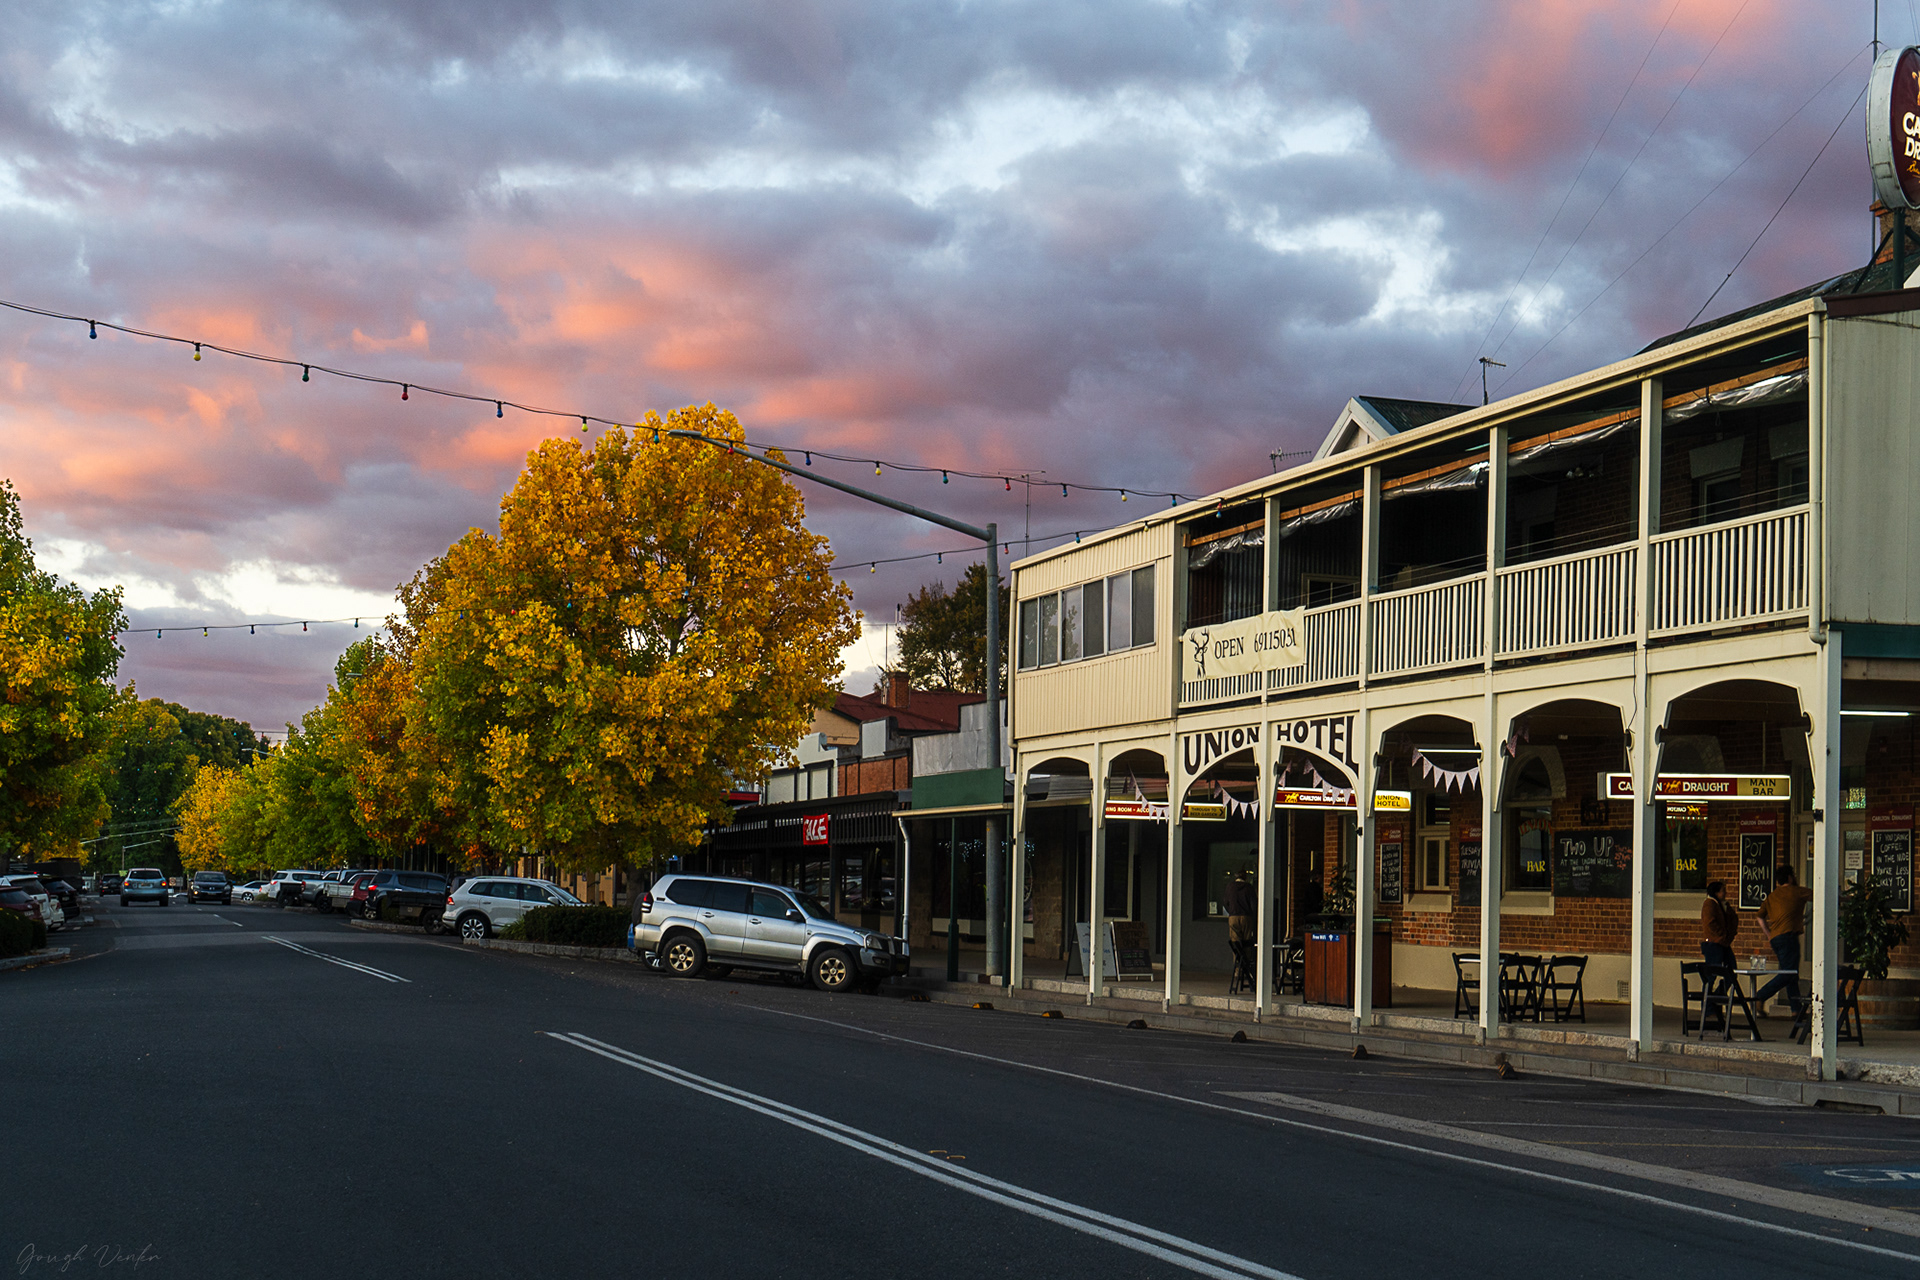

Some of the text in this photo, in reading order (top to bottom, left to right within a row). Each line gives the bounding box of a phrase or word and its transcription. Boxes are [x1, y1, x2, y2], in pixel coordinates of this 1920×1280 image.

[1214, 636, 1244, 660] OPEN
[1184, 716, 1359, 779] UNION HOTEL
[1682, 781, 1730, 792] DRAUGHT
[1749, 778, 1776, 787] MAIN
[1752, 787, 1774, 796] BAR
[1559, 837, 1587, 857] TWO
[1593, 835, 1615, 857] UP
[1744, 837, 1766, 857] POT
[1880, 842, 1903, 853] COFFEE
[1675, 858, 1697, 871] BAR
[1884, 854, 1895, 863] THE
[1526, 860, 1546, 872] BAR
[1742, 865, 1769, 881] PARMI
[1896, 876, 1906, 887] TO
[1746, 884, 1768, 901] $26
